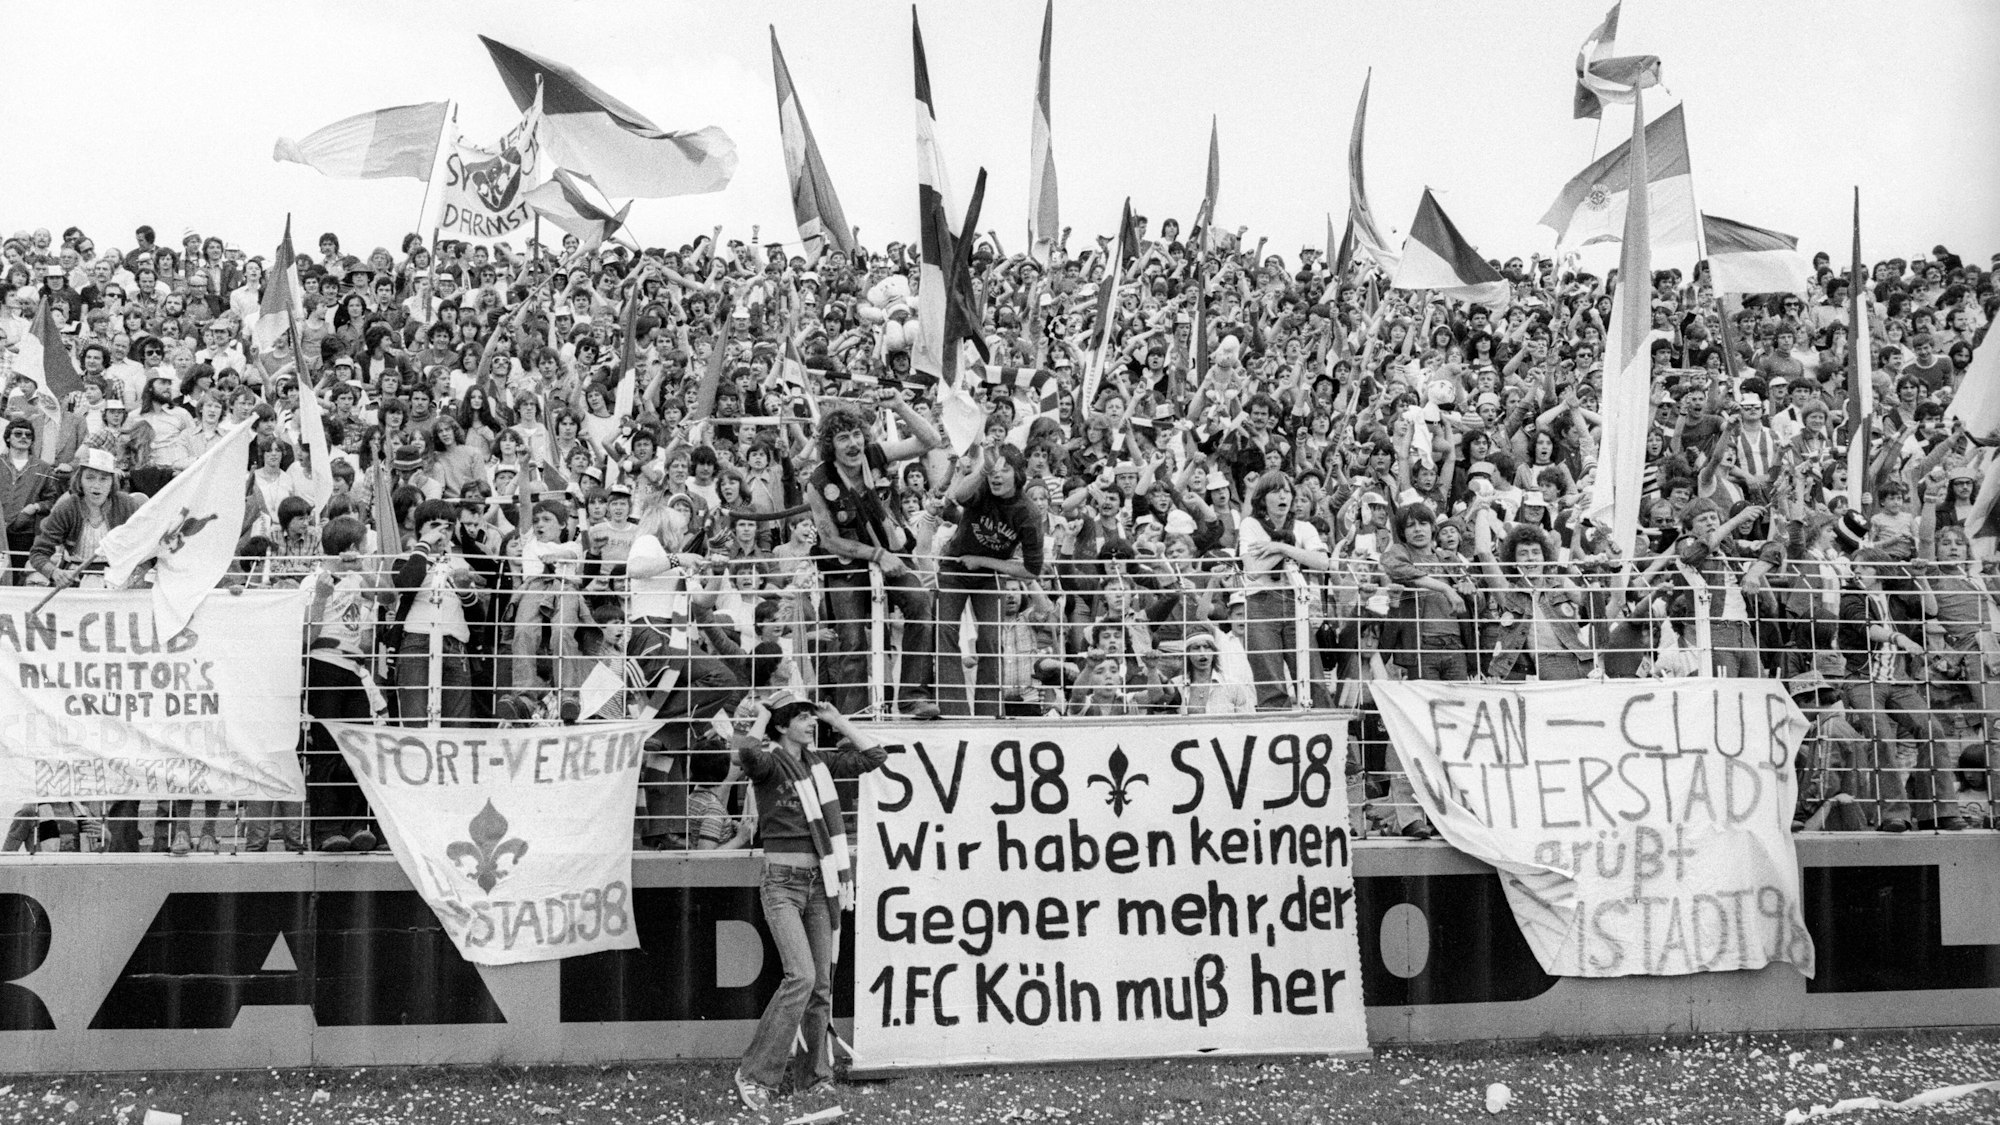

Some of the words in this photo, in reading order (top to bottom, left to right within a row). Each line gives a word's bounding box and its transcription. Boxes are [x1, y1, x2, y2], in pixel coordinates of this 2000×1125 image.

[446, 153, 471, 191] SV
[443, 200, 528, 236] DARMST
[0, 611, 198, 654] AN-CLUB
[19, 658, 214, 690] ALLIGATOR'S
[165, 692, 219, 716] DEN
[35, 757, 212, 797] MEISTER
[338, 730, 649, 786] SPORT-VEREIN
[878, 741, 968, 814] SV
[991, 741, 1069, 815] 98
[1171, 735, 1256, 814] SV
[1263, 733, 1333, 809] 98
[877, 821, 981, 871] Wir
[997, 818, 1176, 874] haben
[1190, 816, 1348, 868] keinen
[877, 887, 1100, 956] Gegner
[976, 962, 1101, 1027] Köln
[1117, 953, 1229, 1027] muß
[1251, 952, 1346, 1015] her
